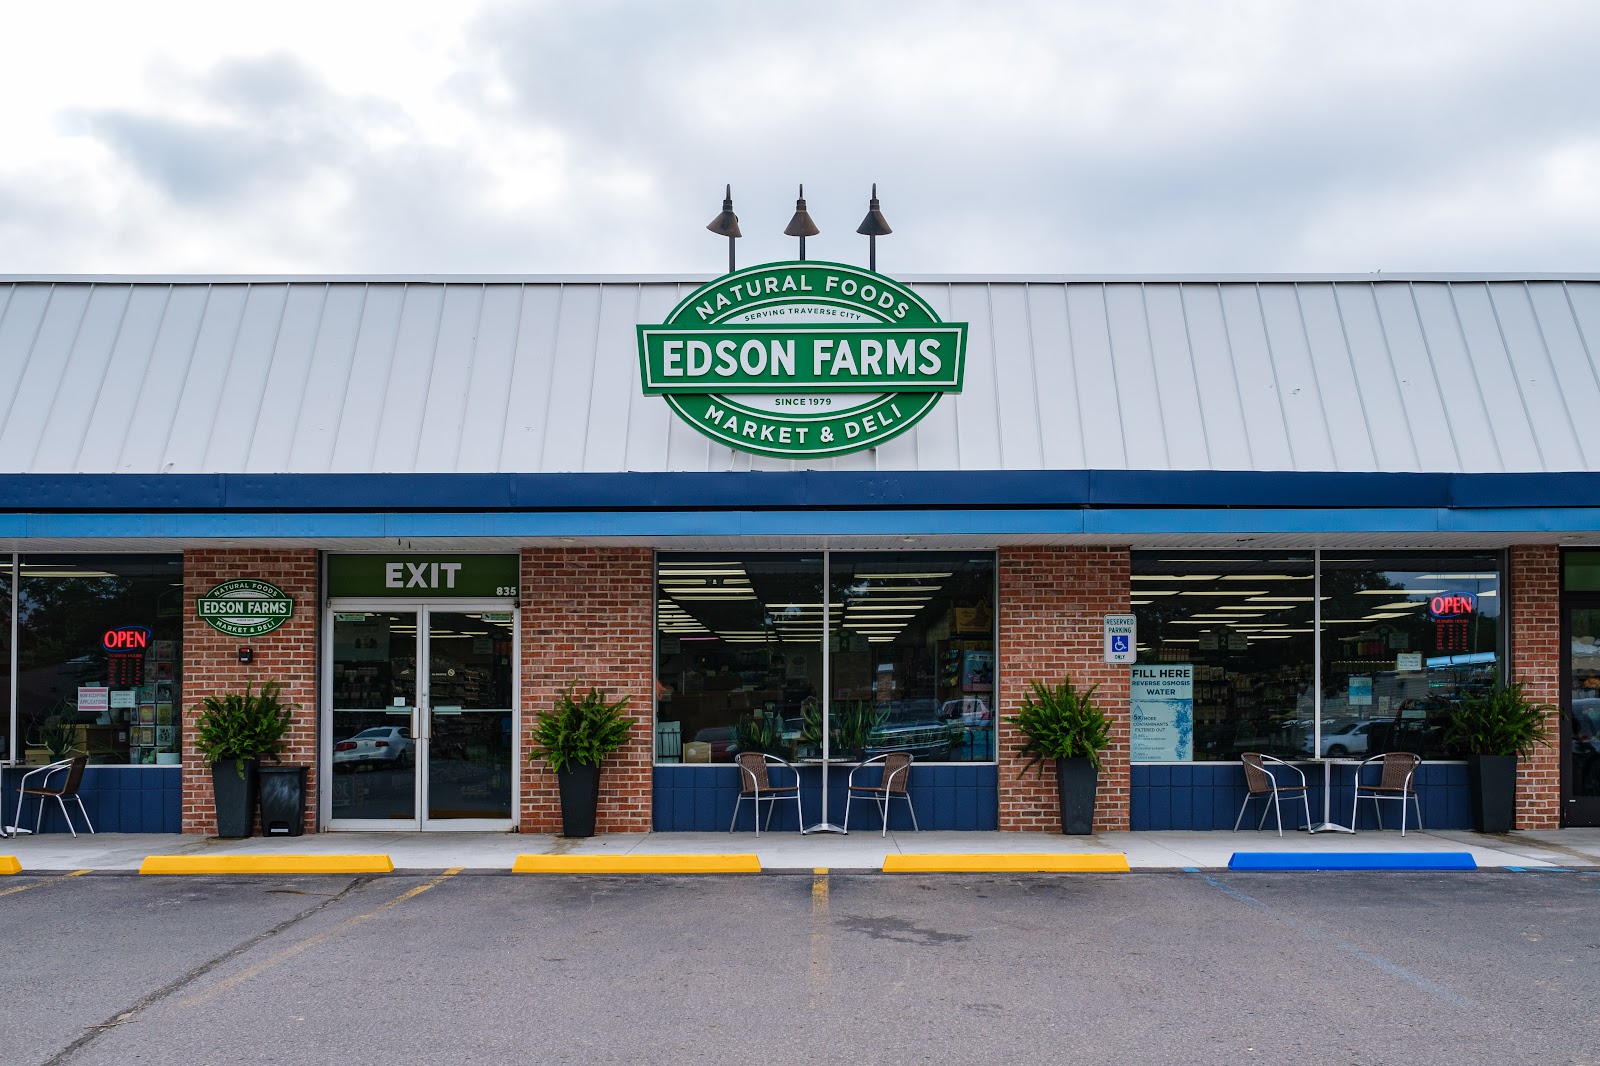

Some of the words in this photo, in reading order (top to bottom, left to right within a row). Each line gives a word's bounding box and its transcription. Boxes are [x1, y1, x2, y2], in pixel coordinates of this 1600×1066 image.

[695, 274, 812, 320] NATURAL
[825, 276, 910, 319] FOODS
[744, 308, 785, 322] SERVING
[788, 308, 837, 316] TRAVERSE
[840, 311, 861, 321] CITY
[663, 339, 796, 377] EDSON
[813, 338, 942, 376] FARMS
[775, 398, 806, 406] SINCE
[809, 398, 832, 406] 1979
[704, 404, 809, 444] MARKET
[820, 426, 834, 443] &
[844, 403, 902, 439] DELI
[385, 562, 462, 588] EXIT
[214, 582, 249, 597] NATURAL
[252, 583, 278, 597] FOODS
[496, 586, 517, 596] 835
[203, 601, 244, 614] EDSON
[247, 601, 287, 614] FARMS
[1431, 596, 1472, 614] OPEN
[216, 620, 247, 633] MARKET
[257, 620, 275, 632] DELI
[104, 630, 146, 648] OPEN
[841, 640, 847, 648] 4
[1220, 636, 1226, 646] 2
[1132, 669, 1156, 678] FILL
[1160, 669, 1190, 678] HERE
